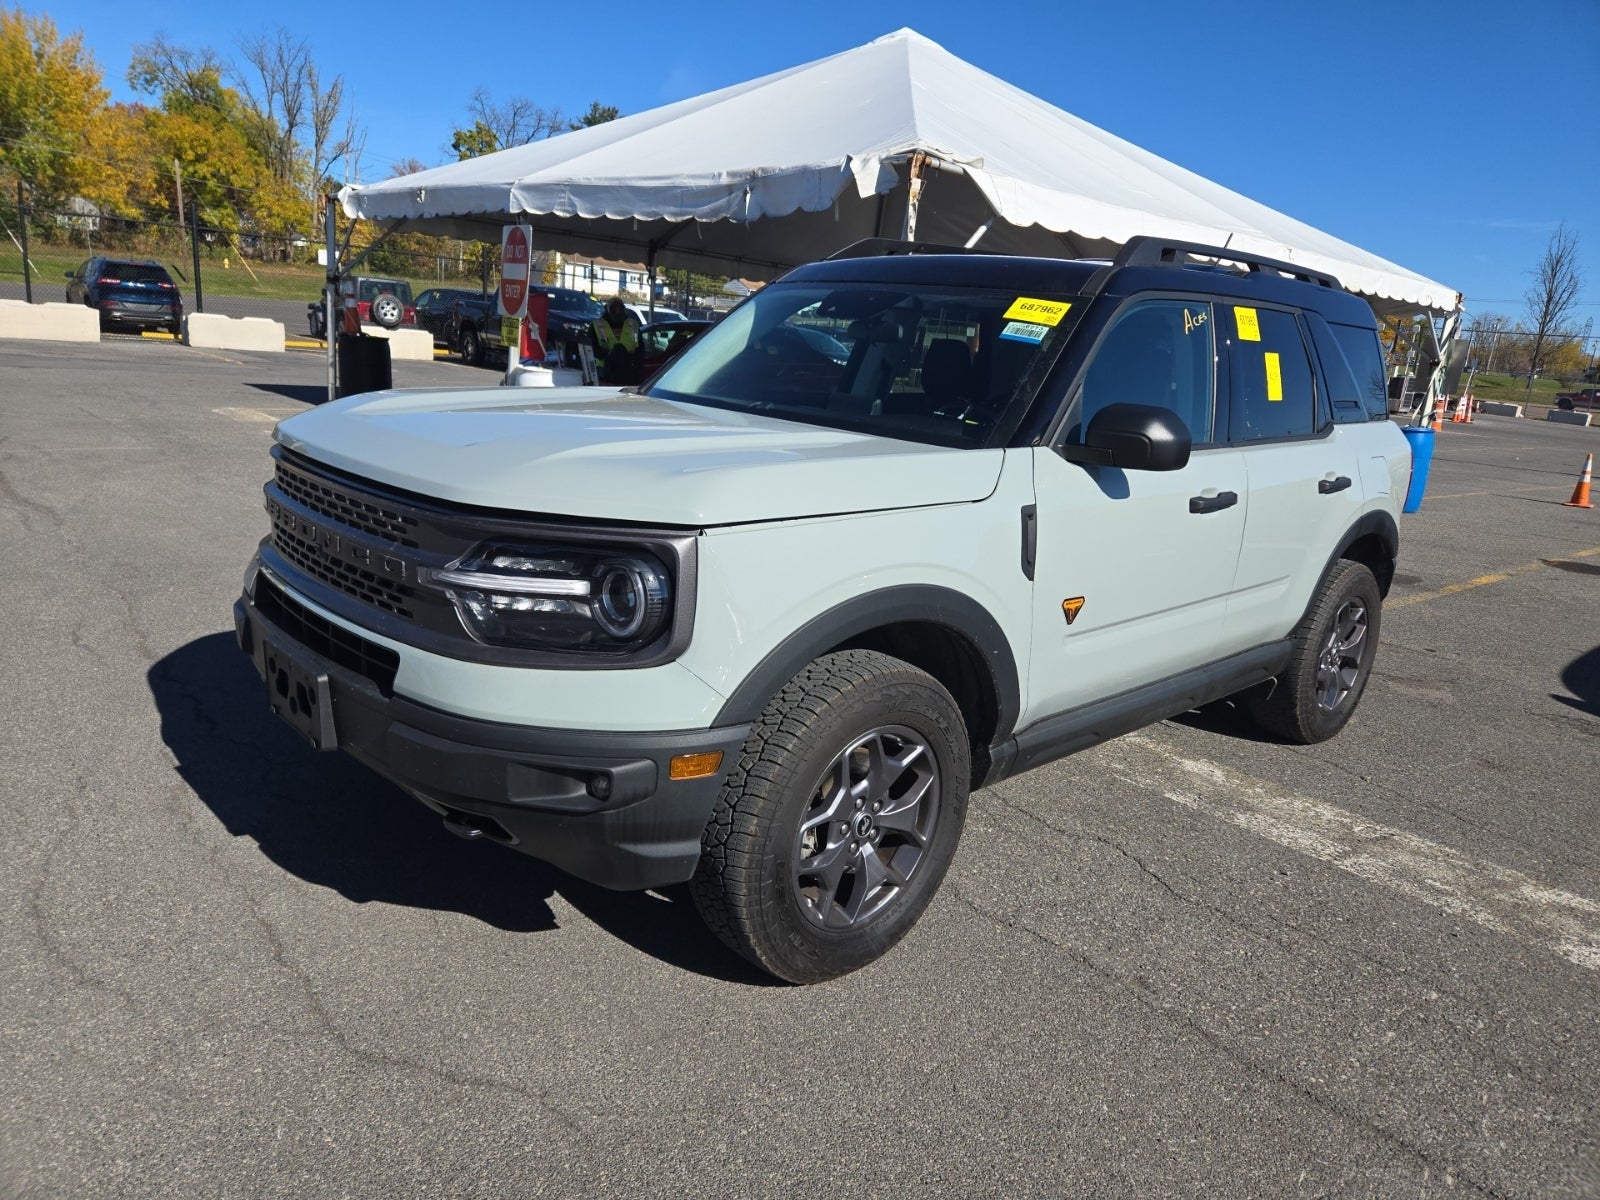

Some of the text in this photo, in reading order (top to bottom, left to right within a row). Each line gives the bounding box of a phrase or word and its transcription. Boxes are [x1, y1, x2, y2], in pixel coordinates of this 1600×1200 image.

[506, 245, 525, 258] DO NOT
[505, 284, 521, 298] ENTER
[1020, 303, 1062, 315] 687962
[269, 498, 406, 581] BRONCO
